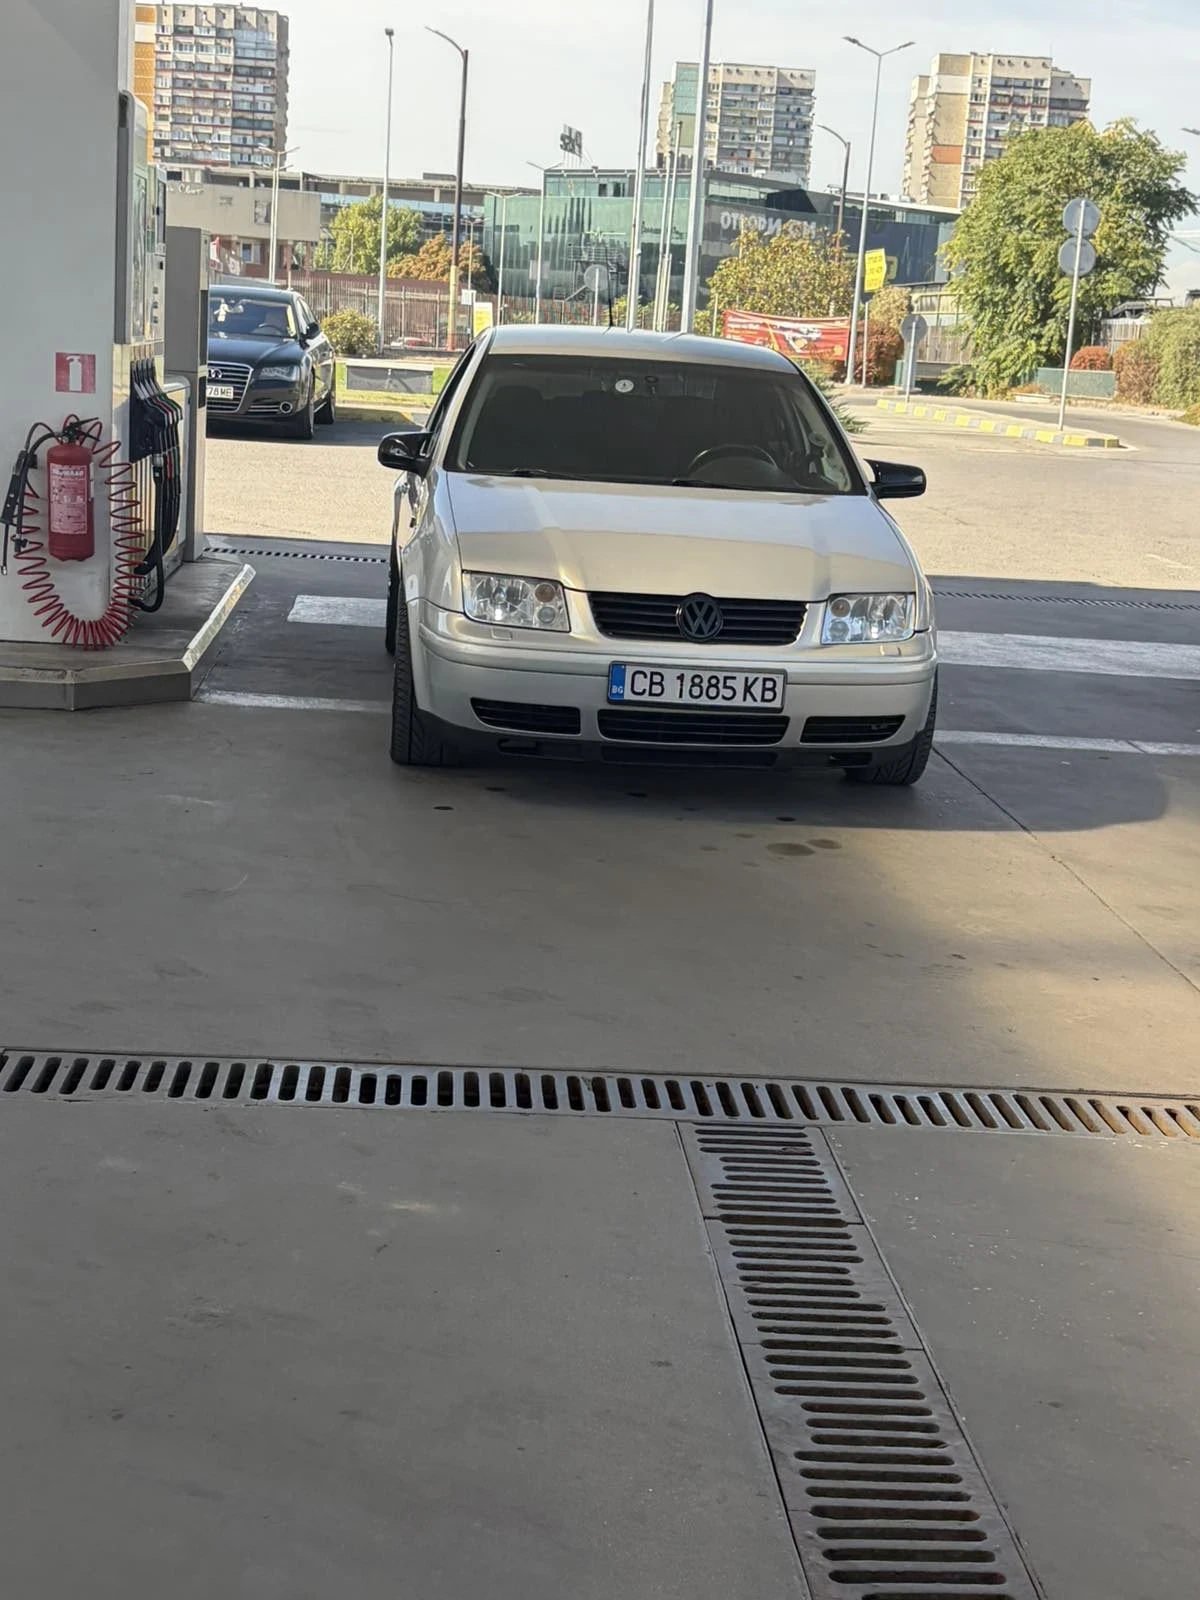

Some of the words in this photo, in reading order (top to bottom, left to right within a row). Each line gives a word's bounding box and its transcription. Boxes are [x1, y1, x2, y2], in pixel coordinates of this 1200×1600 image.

[681, 597, 721, 638] VW
[611, 685, 624, 695] BG
[630, 670, 665, 697] CB
[676, 673, 737, 700] 1885
[743, 676, 777, 703] KB
